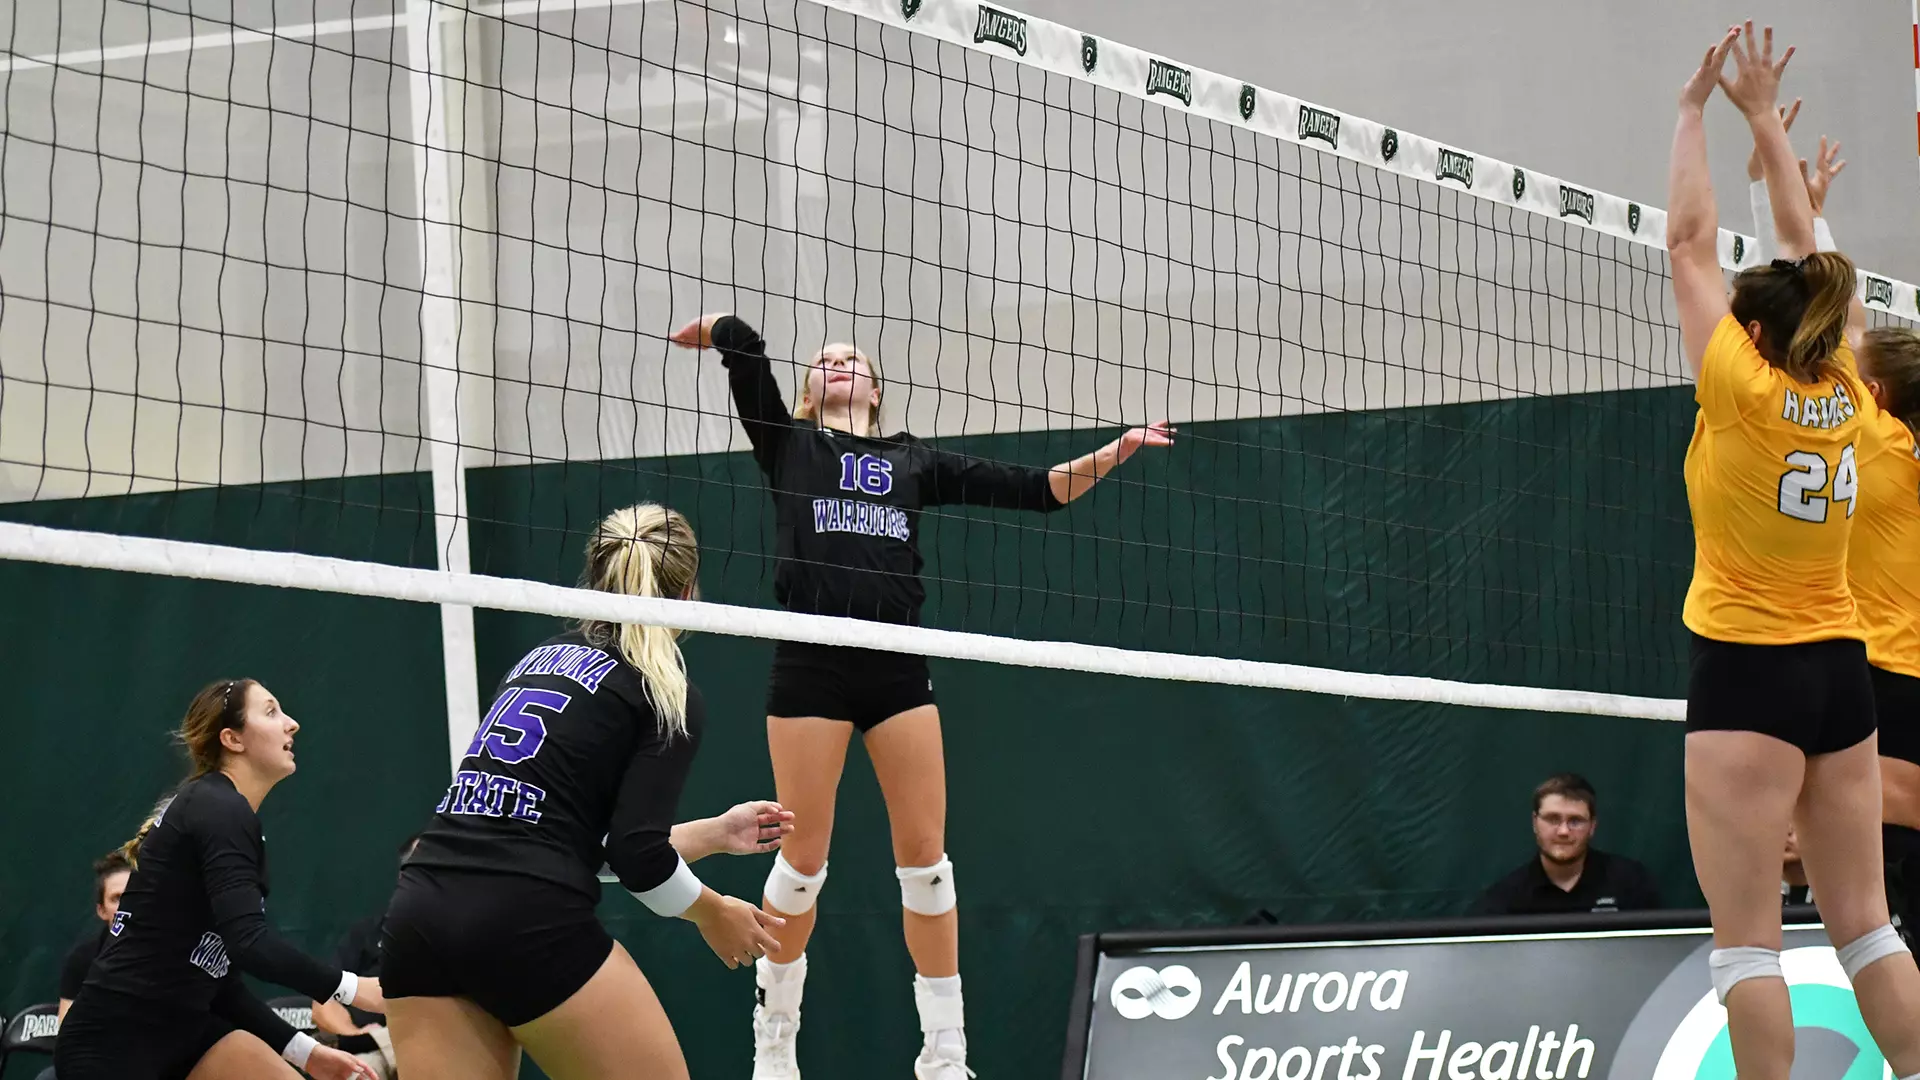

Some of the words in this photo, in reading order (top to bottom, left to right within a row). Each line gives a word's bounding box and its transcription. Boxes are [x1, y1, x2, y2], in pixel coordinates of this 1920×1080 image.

[974, 6, 1027, 55] RANGERS
[1147, 60, 1191, 105] RANGERS
[840, 453, 893, 496] 16
[1778, 442, 1858, 523] 24
[813, 499, 910, 542] WARRIORS
[506, 644, 619, 694] WINONA
[463, 687, 572, 765] 15
[1212, 961, 1409, 1015] Aurora
[1205, 1034, 1385, 1080] Sports
[1402, 1023, 1595, 1080] Health
